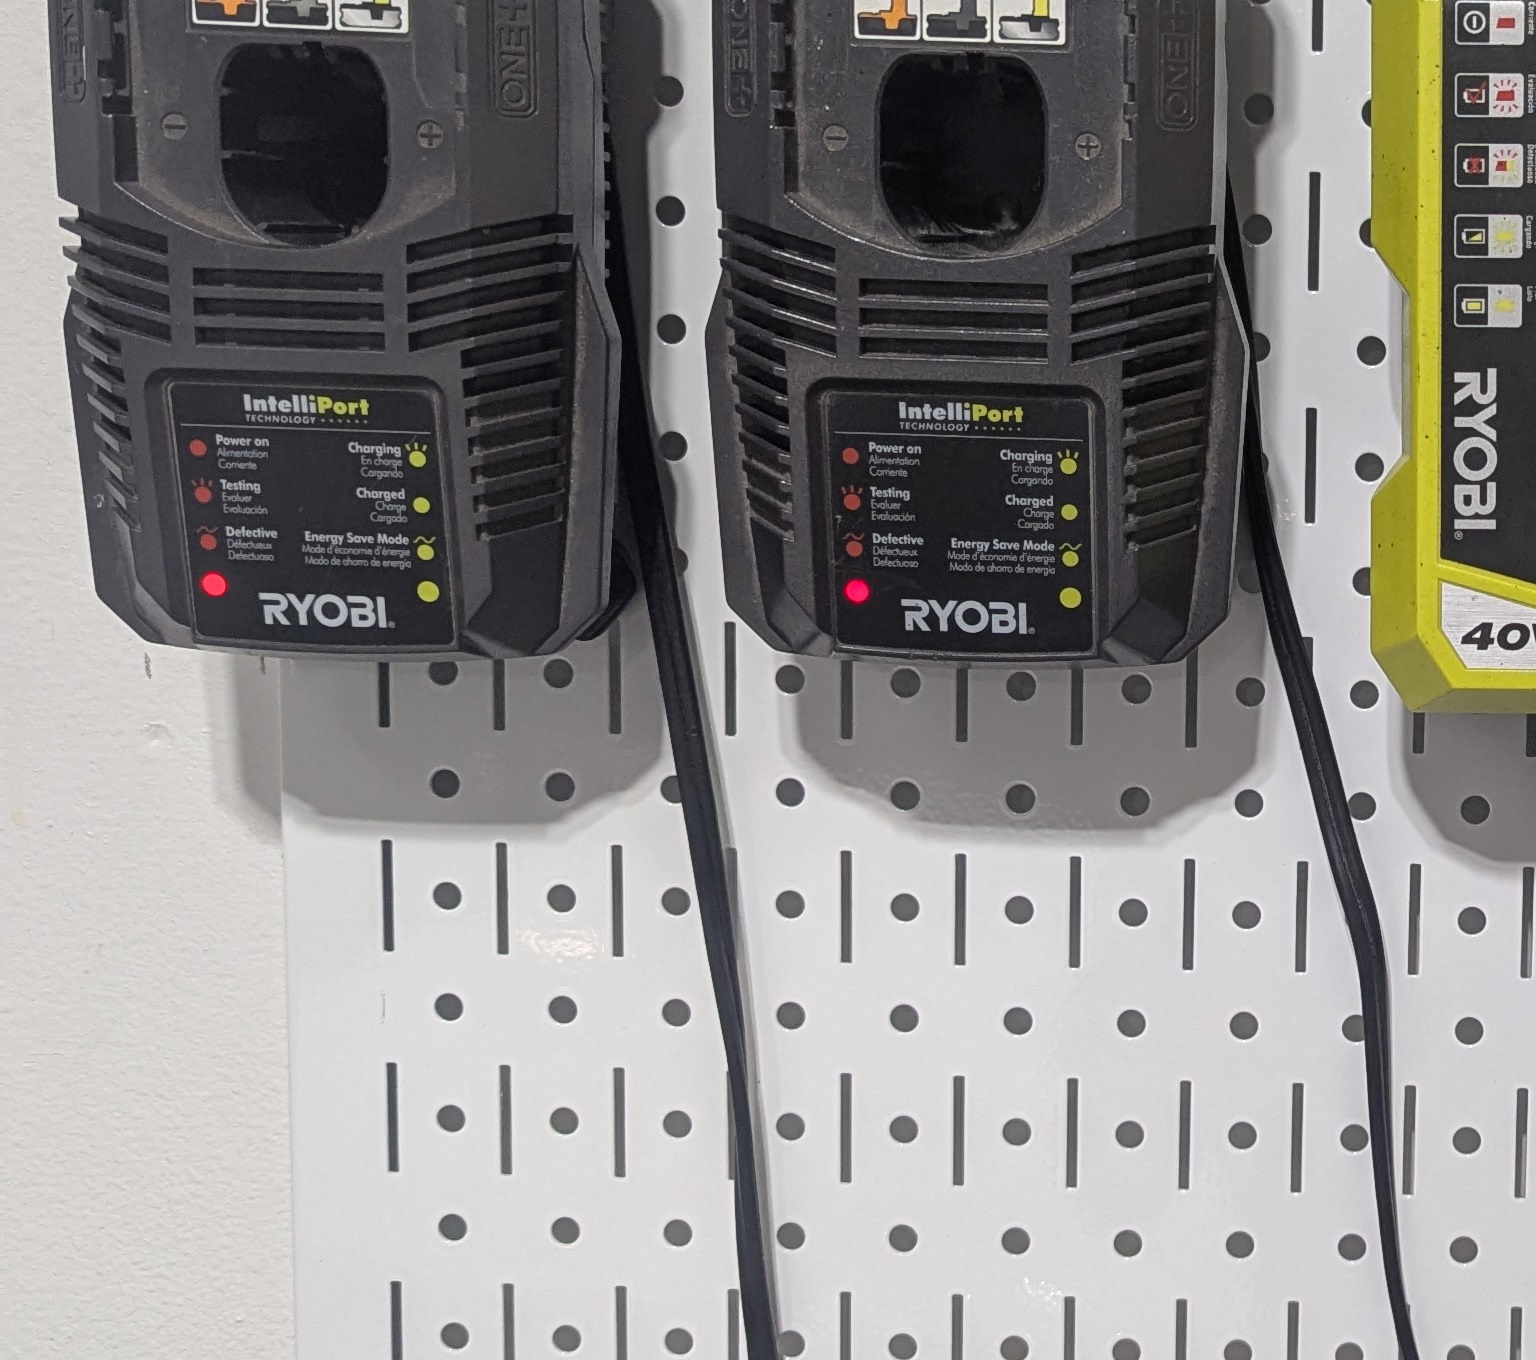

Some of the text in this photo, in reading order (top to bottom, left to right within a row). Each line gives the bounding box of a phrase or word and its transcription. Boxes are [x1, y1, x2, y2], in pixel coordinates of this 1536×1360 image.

[243, 393, 369, 415] IntelliPort
[246, 414, 316, 424] TECHNOLOGY
[899, 402, 1023, 423] IntelliPort
[900, 422, 969, 432] TECHNOLOGY
[216, 434, 269, 447] Power on
[348, 442, 401, 456] Charging
[869, 442, 921, 454] Power on
[1454, 368, 1497, 530] RYOBI
[1000, 450, 1052, 463] Charging
[1012, 465, 1053, 475] En charge
[220, 480, 261, 493] Testing
[1012, 475, 1053, 486] Cargando
[356, 488, 405, 500] Charged
[870, 487, 910, 500] Testing
[1005, 495, 1053, 507] Charged
[226, 527, 277, 538] Defective
[305, 531, 409, 545] Energy Save Mode
[873, 534, 924, 545] Defective
[951, 538, 1054, 552] Energy Save Mode
[258, 593, 388, 628] RYOBI
[901, 599, 1027, 634] RYOBI
